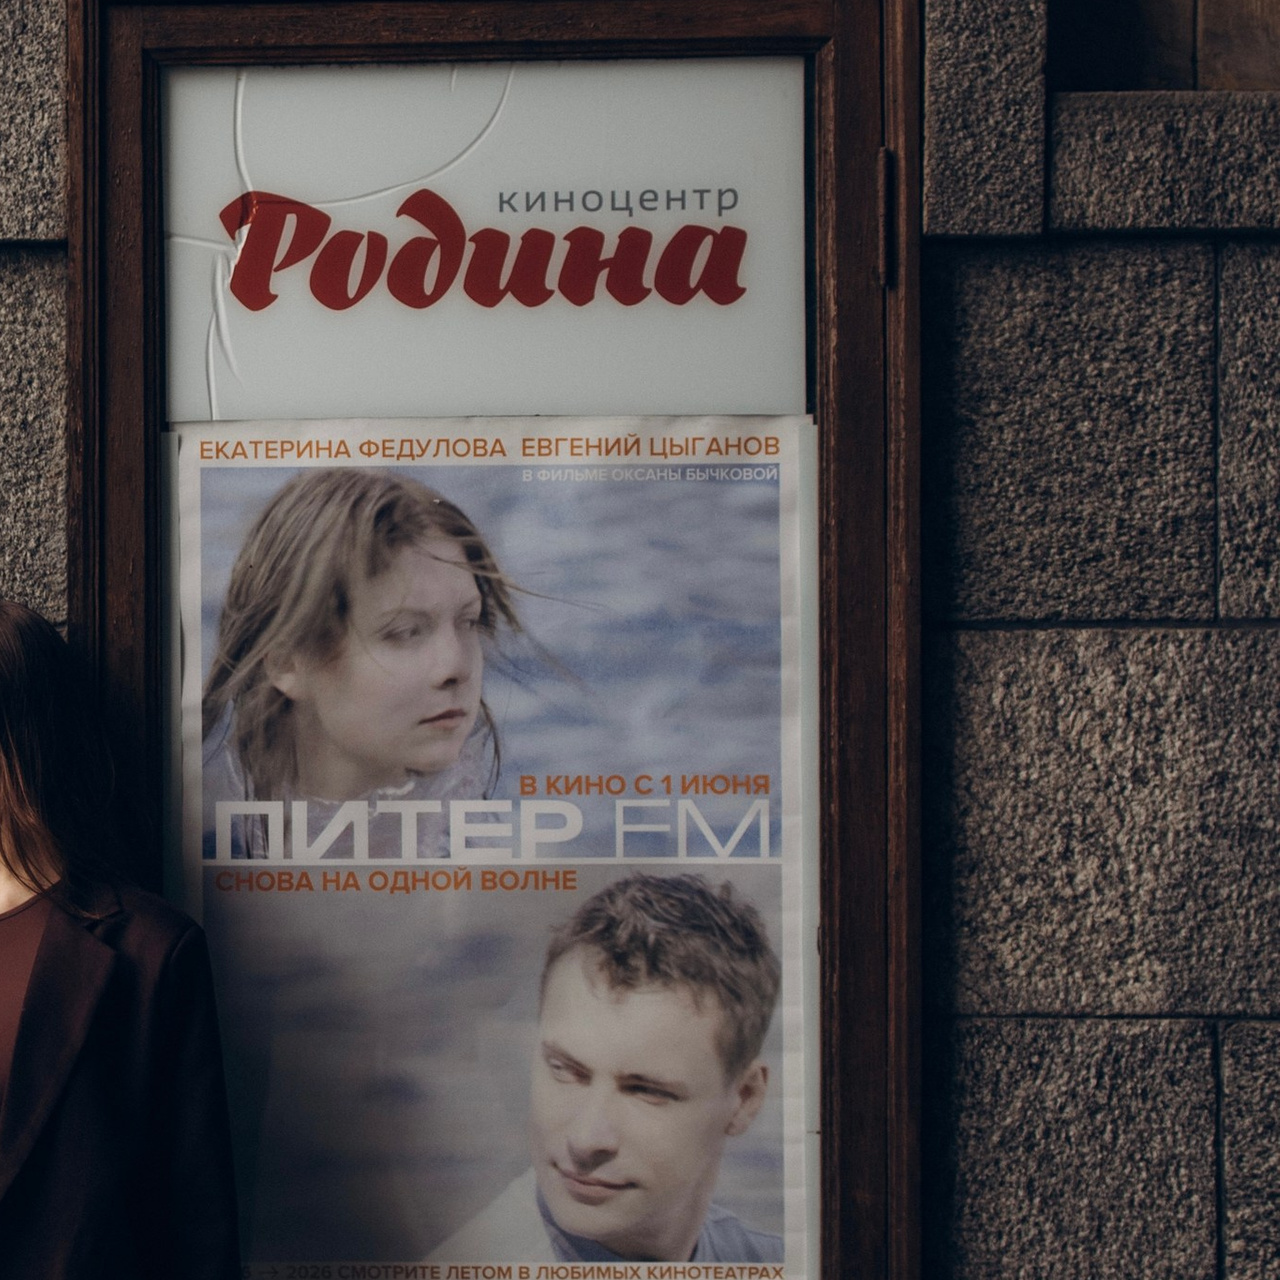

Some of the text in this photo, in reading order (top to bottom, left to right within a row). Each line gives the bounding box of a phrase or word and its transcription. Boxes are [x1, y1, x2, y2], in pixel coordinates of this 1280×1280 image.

[498, 185, 740, 216] киноцентр
[219, 188, 748, 312] Родина
[200, 433, 780, 461] ЕКАТЕРИНА ФЕДУЛОВА ЕВГЕНИЙ ЦЫГАНОВ
[522, 466, 778, 482] В ФИЛЬМЕ ОКСАНЫ БЫЧКОВОЙ
[520, 775, 770, 795] В КИНО С 1 ИЮНЯ
[215, 798, 770, 860] ПИТЕР FM
[215, 867, 578, 894] СНОВА НА ОДНОЙ ВОЛНЕ
[286, 1265, 784, 1280] 2026 СМОТРИТЕ ЛЕТОМ В ЛЮБИМЫХ КИНОТЕАТРАХ
